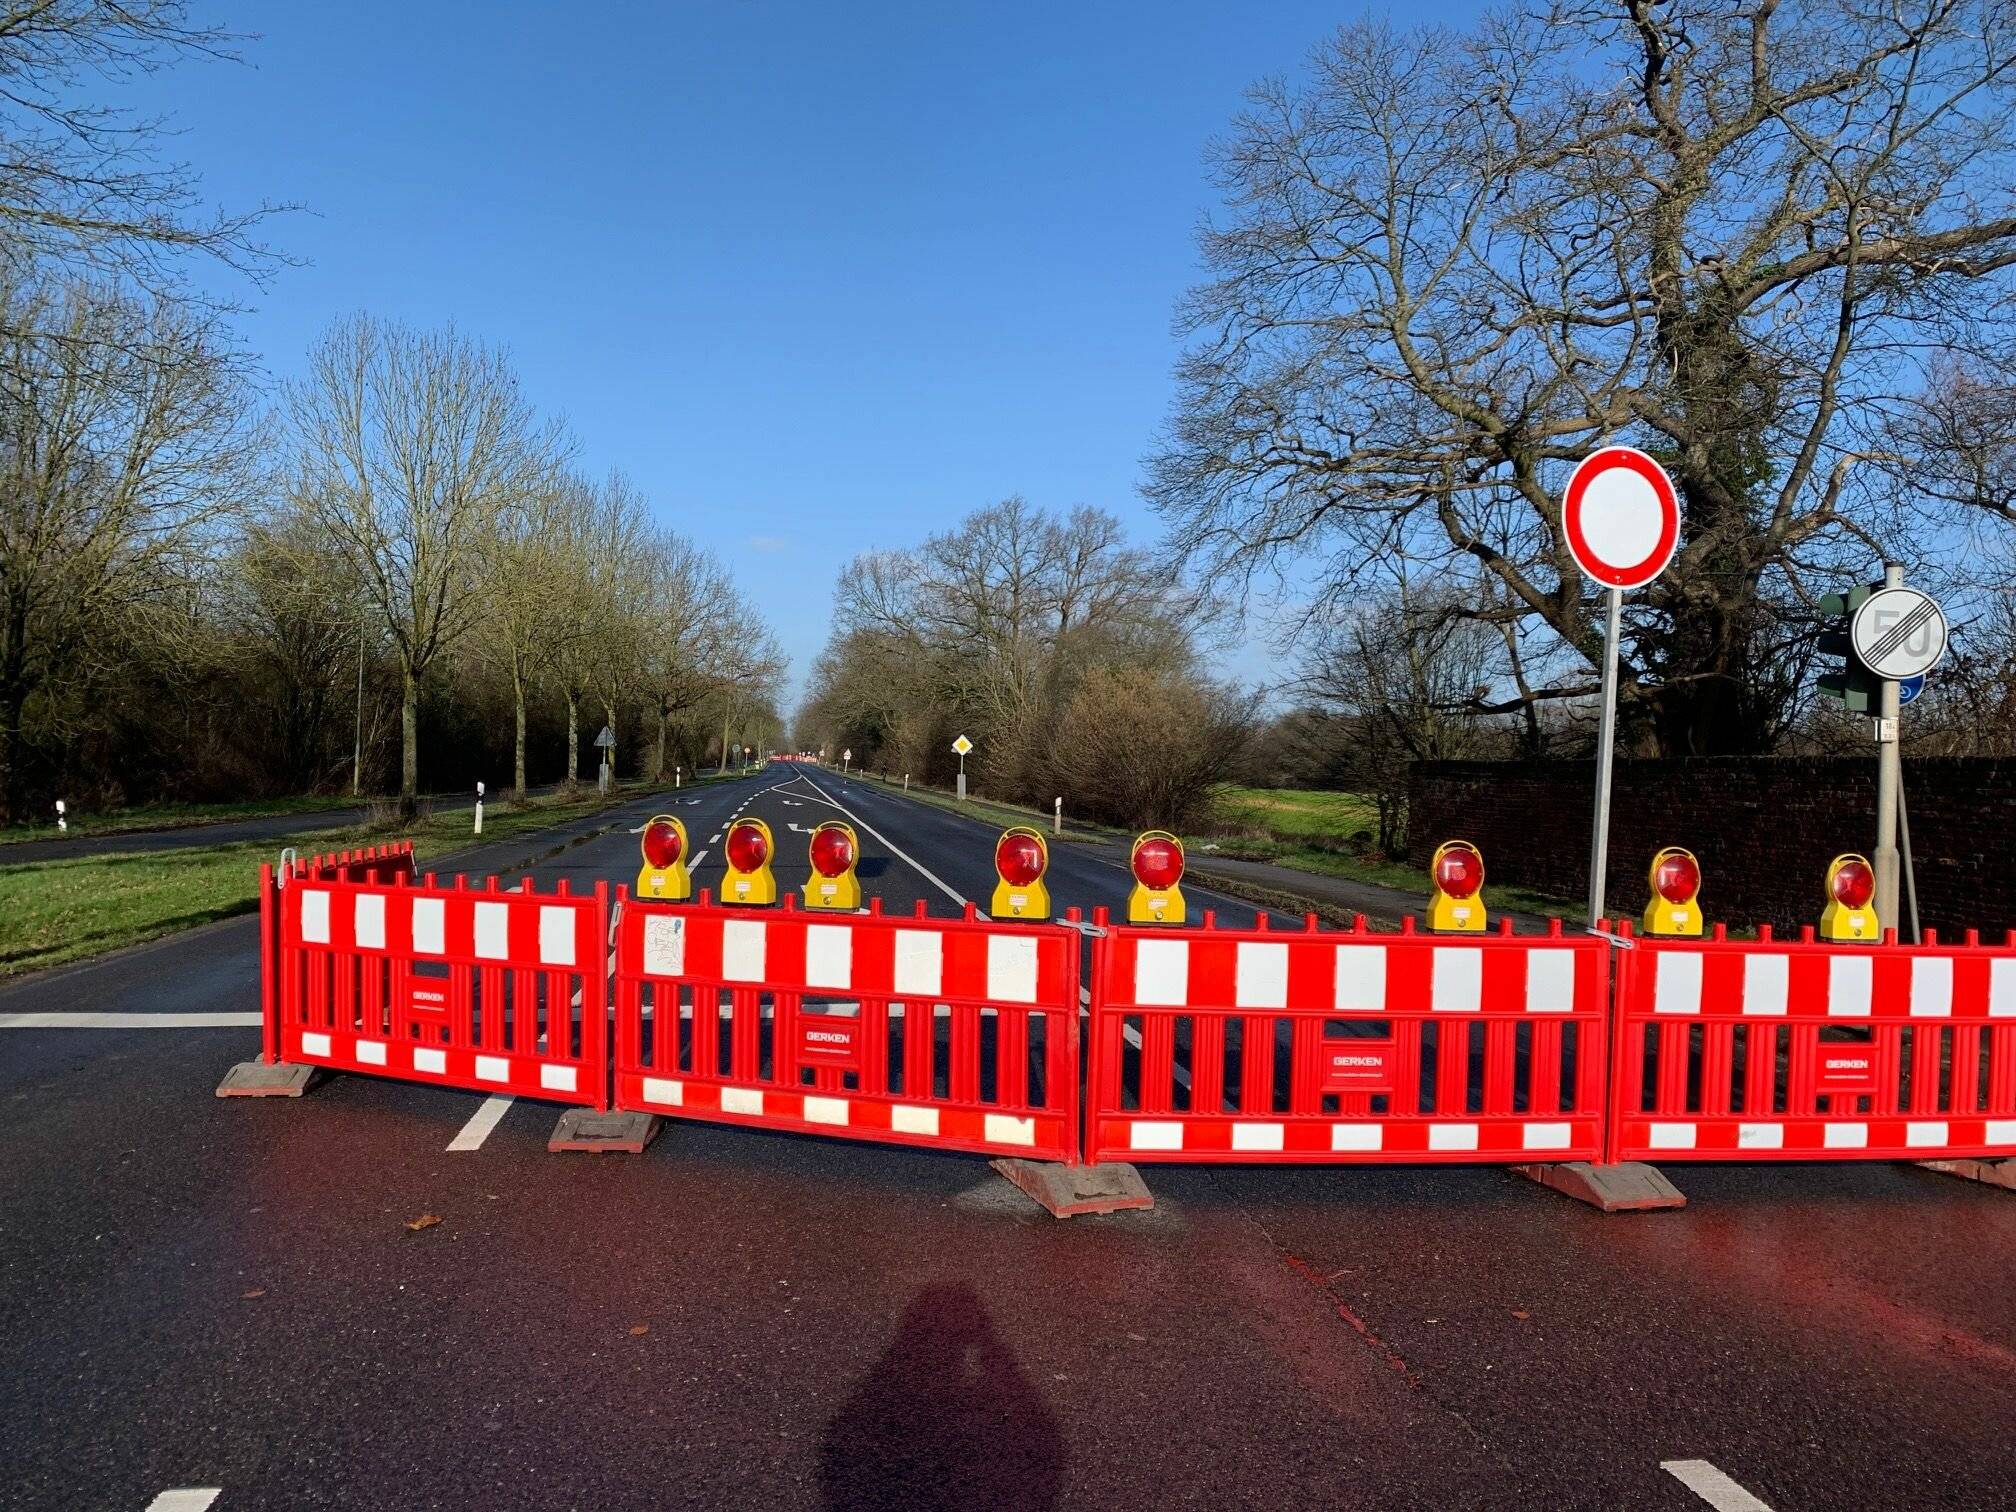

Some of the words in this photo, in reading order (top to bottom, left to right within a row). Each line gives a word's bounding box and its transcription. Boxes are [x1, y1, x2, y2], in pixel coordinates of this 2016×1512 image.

[1874, 610, 1931, 657] 50
[412, 991, 444, 1002] GERKEN
[806, 1031, 850, 1043] GERKEN
[1333, 1056, 1382, 1066] GERKEN
[1825, 1059, 1869, 1069] GERKEN
